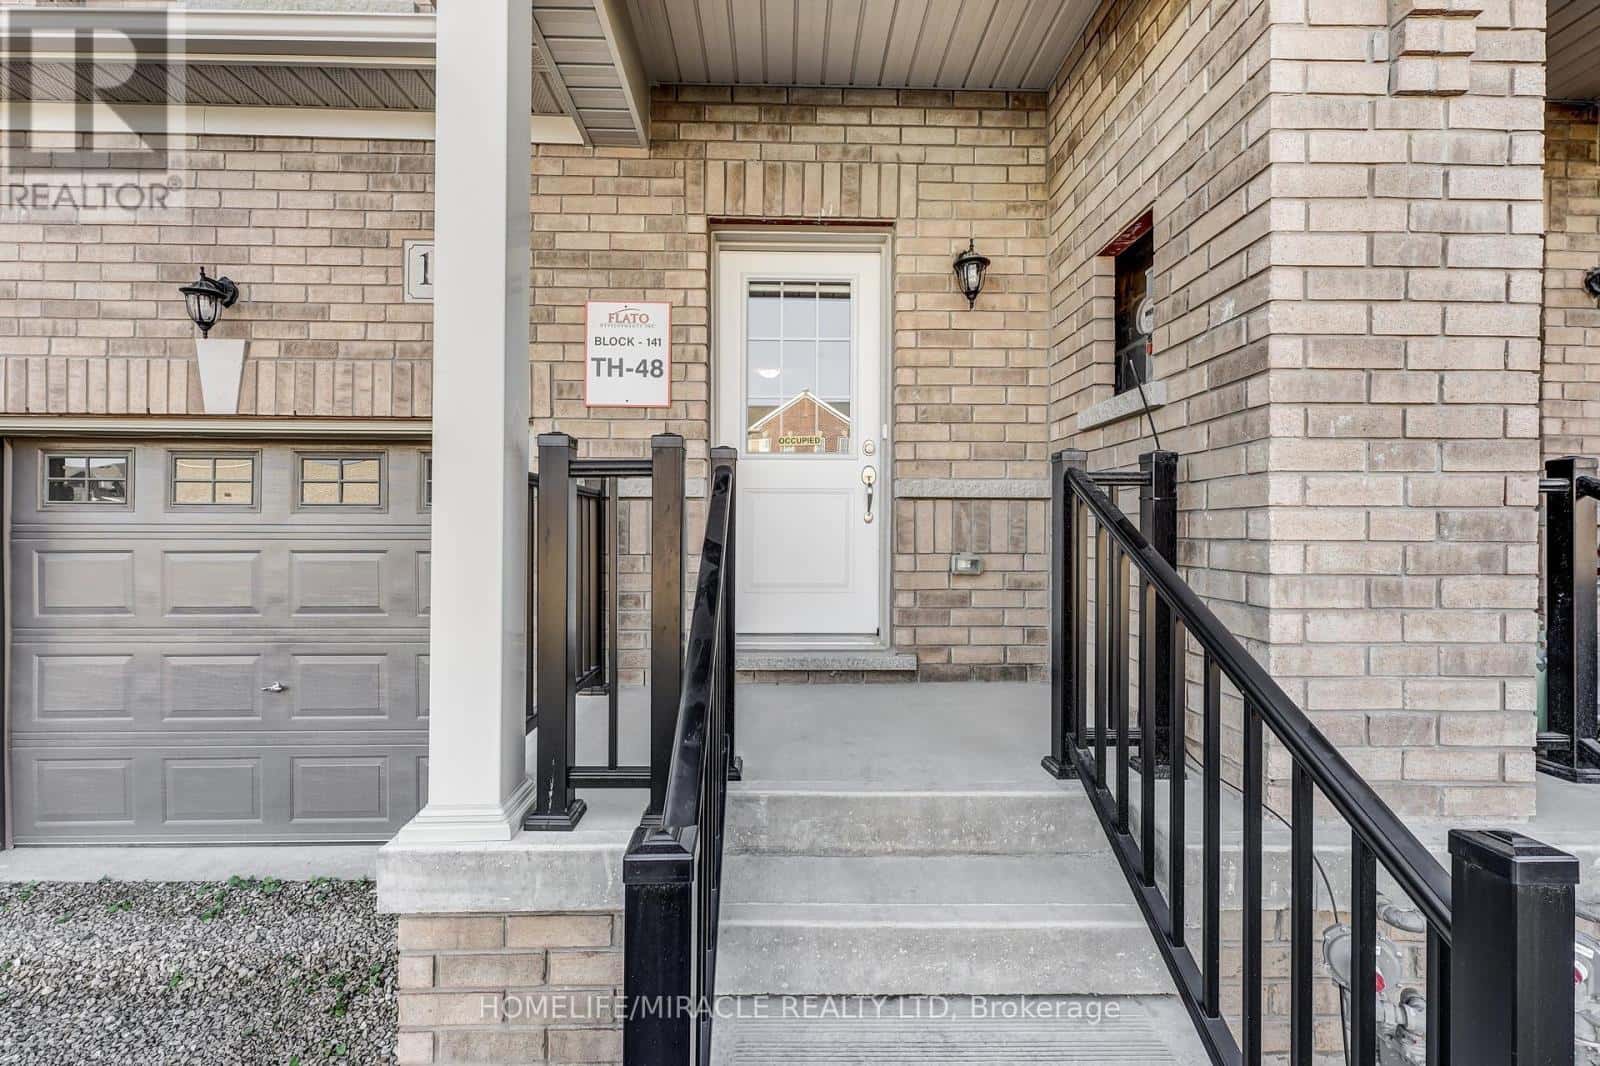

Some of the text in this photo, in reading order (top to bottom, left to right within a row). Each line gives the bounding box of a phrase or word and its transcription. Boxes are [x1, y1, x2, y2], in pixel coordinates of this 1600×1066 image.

[608, 313, 650, 324] FLATO
[594, 336, 635, 347] BLOCK
[646, 338, 662, 347] 141
[591, 357, 664, 378] TH-48
[778, 436, 821, 445] OCCUPIED
